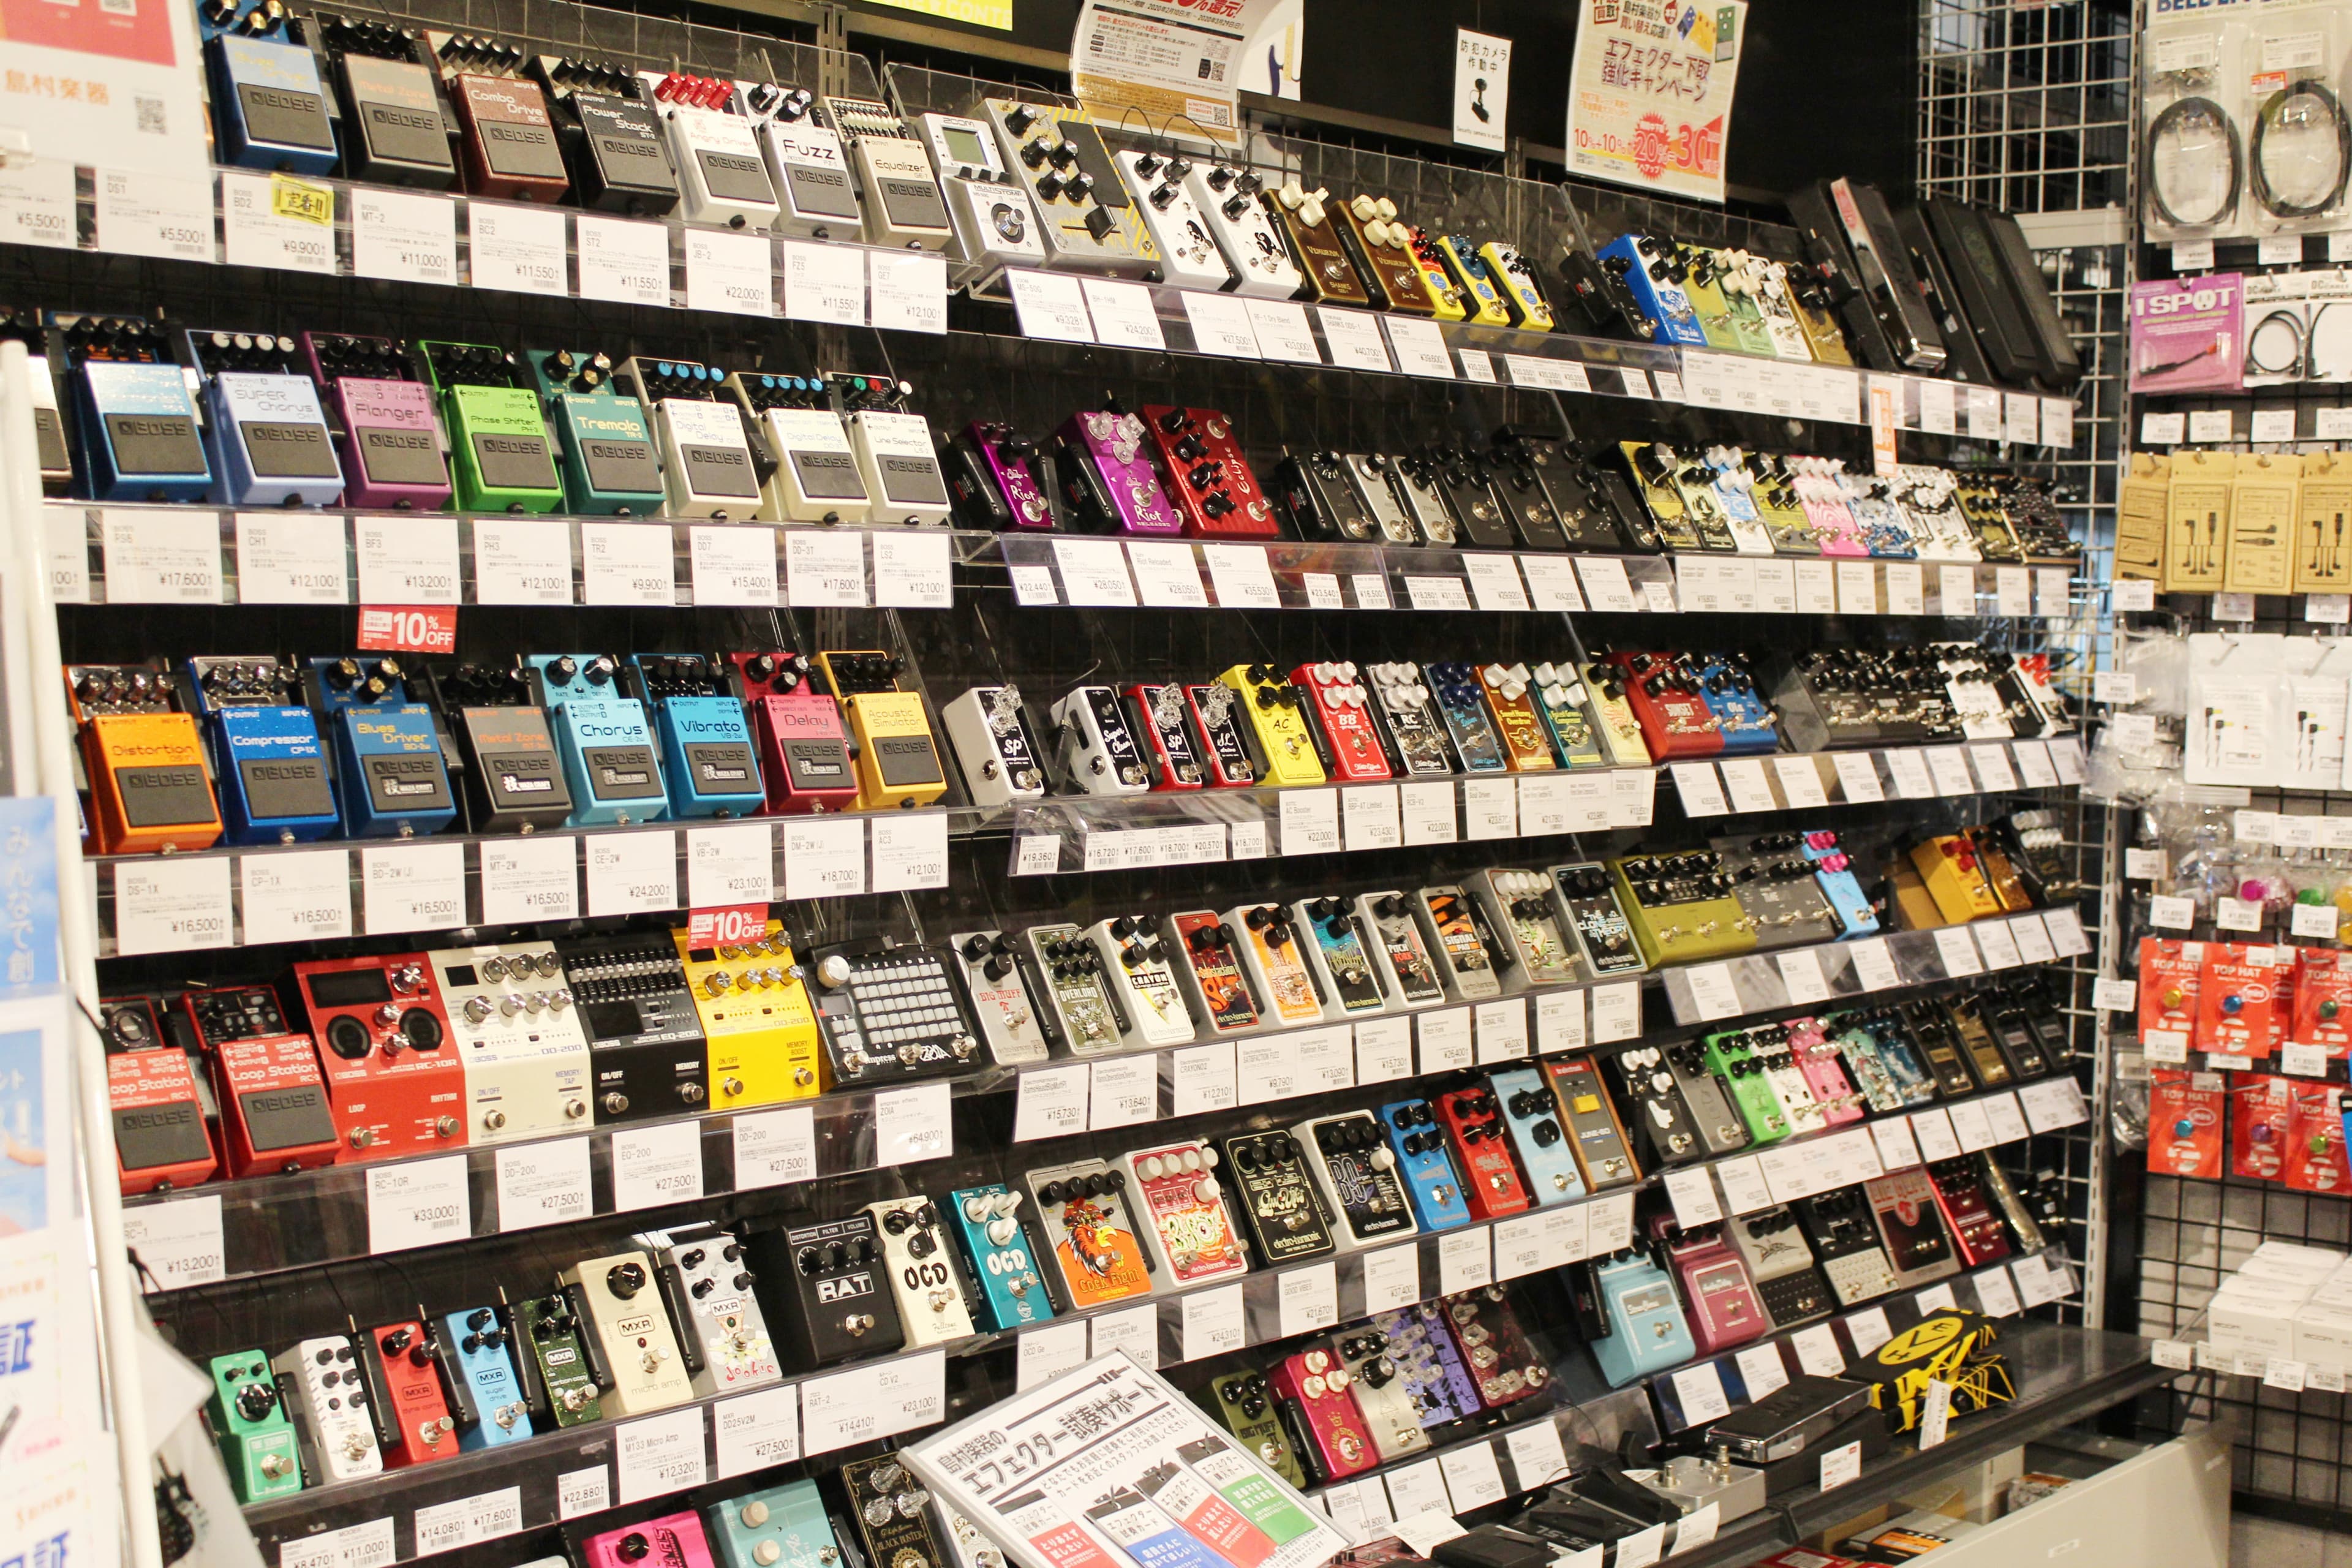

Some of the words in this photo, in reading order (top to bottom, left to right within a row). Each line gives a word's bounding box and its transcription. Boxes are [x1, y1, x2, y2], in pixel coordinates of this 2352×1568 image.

[1461, 39, 1507, 61] 防犯カメラ
[1468, 56, 1497, 73] 作動中
[1605, 37, 1711, 80] エフェクター下取
[5, 69, 110, 105] 島村楽器
[1602, 59, 1706, 102] 強化キャンペーン
[470, 89, 516, 104] Combo
[507, 103, 543, 116] Drive
[584, 104, 624, 119] Power
[616, 118, 653, 134] Stack
[783, 140, 835, 159] Fuzz
[875, 159, 925, 172] Equalizer
[973, 184, 1021, 197] MULTISTOMP
[361, 212, 386, 224] MT-2
[401, 251, 443, 268] ¥11,000
[516, 263, 554, 279] ¥11,550
[620, 274, 660, 290] ¥11,550
[726, 285, 760, 301] ¥22,000
[823, 295, 856, 311] ¥11,550
[907, 304, 938, 320] ¥12,100
[1222, 335, 1250, 347] ¥27,500
[1285, 341, 1311, 352] ¥33,000
[1355, 346, 1381, 357] ¥40,700
[234, 389, 288, 401] SUPER
[257, 401, 314, 413] Chorus
[355, 402, 424, 420] Flanger
[470, 415, 503, 426] Phase
[507, 417, 537, 426] Shifter
[577, 416, 641, 432] Tremolo
[696, 431, 723, 443] Delay
[1011, 484, 1035, 501] Riot
[1134, 507, 1161, 522] Riot
[1214, 559, 1232, 567] Eclipse
[159, 572, 206, 586] ¥17,600
[289, 575, 334, 588] ¥12,100
[404, 575, 446, 588] ¥13,200
[521, 577, 560, 590] ¥12,100
[1168, 584, 1196, 595] ¥28,050
[1245, 586, 1273, 596] ¥35,530
[428, 615, 439, 630] %
[393, 612, 428, 647] 10
[426, 631, 453, 646] OFF
[869, 709, 913, 718] Acoustic
[1338, 714, 1357, 725] BB
[1401, 714, 1417, 724] RC
[680, 720, 741, 733] Vibrato
[785, 714, 828, 728] Delay
[873, 717, 921, 727] Simulator
[1273, 718, 1289, 729] AC
[357, 723, 396, 734] Blues
[581, 724, 643, 737] Chorus
[232, 736, 314, 747] Compressor
[382, 733, 428, 744] Driver
[112, 745, 194, 755] Distortion
[1235, 839, 1261, 848] ¥18,700
[1308, 832, 1332, 842] ¥22,000
[1194, 840, 1223, 850] ¥20,570
[595, 853, 620, 863] CE-2W
[489, 861, 518, 870] MT-2W
[252, 876, 281, 887] CP-1X
[127, 886, 159, 895] DS-1X
[629, 885, 665, 897] ¥24,200
[526, 894, 565, 905] ¥16,500
[412, 902, 452, 913] ¥16,500
[293, 910, 336, 922] ¥16,500
[743, 913, 753, 922] %
[172, 920, 219, 932] ¥16,500
[715, 912, 741, 940] 10
[742, 925, 764, 937] OFF
[1446, 934, 1477, 945] SIGNAL
[1389, 943, 1409, 954] PITCH
[2152, 959, 2173, 970] TOP
[2177, 960, 2198, 970] HAT
[2214, 965, 2236, 975] TOP
[2239, 967, 2261, 978] HAT
[1132, 973, 1169, 984] CRAYON
[979, 990, 997, 1002] BIG
[1000, 989, 1022, 1000] MUFF
[1059, 987, 1098, 1001] OVERLORD
[662, 1030, 699, 1041] EQ-200
[541, 1044, 582, 1055] DD-200
[232, 1069, 264, 1080] Loop
[268, 1061, 317, 1073] Station
[415, 1060, 457, 1071] RC-10R
[676, 1061, 699, 1070] MEMORY
[140, 1076, 189, 1090] Station
[1268, 1076, 1292, 1087] ¥9,790
[431, 1093, 457, 1102] RHYTHM
[1203, 1088, 1231, 1099] ¥12,210
[2162, 1090, 2185, 1099] TOP
[2188, 1091, 2211, 1101] HAT
[349, 1105, 366, 1114] LOOP
[622, 1147, 651, 1161] EQ-200
[769, 1157, 803, 1172] ¥27,500
[505, 1166, 536, 1178] DD-200
[375, 1177, 409, 1189] RC-10R
[655, 1175, 692, 1190] ¥27,500
[541, 1193, 579, 1208] ¥27,500
[413, 1206, 454, 1222] ¥33,000
[1273, 1231, 1322, 1249] electro-harmonix
[167, 1257, 214, 1273] ¥13,200
[904, 1262, 949, 1289] OCD
[1080, 1277, 1107, 1293] Cock
[1110, 1268, 1140, 1285] Fight
[818, 1276, 873, 1302] RAT
[621, 1321, 653, 1335] MXR
[725, 1363, 774, 1382] dookie
[485, 1386, 506, 1395] sugar
[631, 1383, 658, 1396] micro
[661, 1380, 682, 1392] amp
[903, 1398, 933, 1412] ¥23,100
[723, 1415, 755, 1429] DD25V2M
[839, 1418, 870, 1433] ¥14,410
[960, 1379, 1160, 1496] エフェクター試奏サポート
[755, 1441, 789, 1456] ¥27,500
[937, 1428, 1007, 1474] 島村楽器の
[659, 1462, 694, 1478] ¥12,320
[1203, 1454, 1238, 1474] エフェクター
[564, 1487, 600, 1502] ¥22,880
[1161, 1479, 1191, 1506] エフェクター
[473, 1509, 511, 1525] ¥17,600
[1011, 1504, 1054, 1525] エフェクター
[1107, 1509, 1153, 1531] エフェクター
[1196, 1502, 1225, 1531] とりあえず
[421, 1521, 460, 1538] ¥14,080
[1039, 1528, 1082, 1550] とりあえず
[343, 1540, 385, 1559] ¥11,000
[1050, 1537, 1090, 1558] 試したい!
